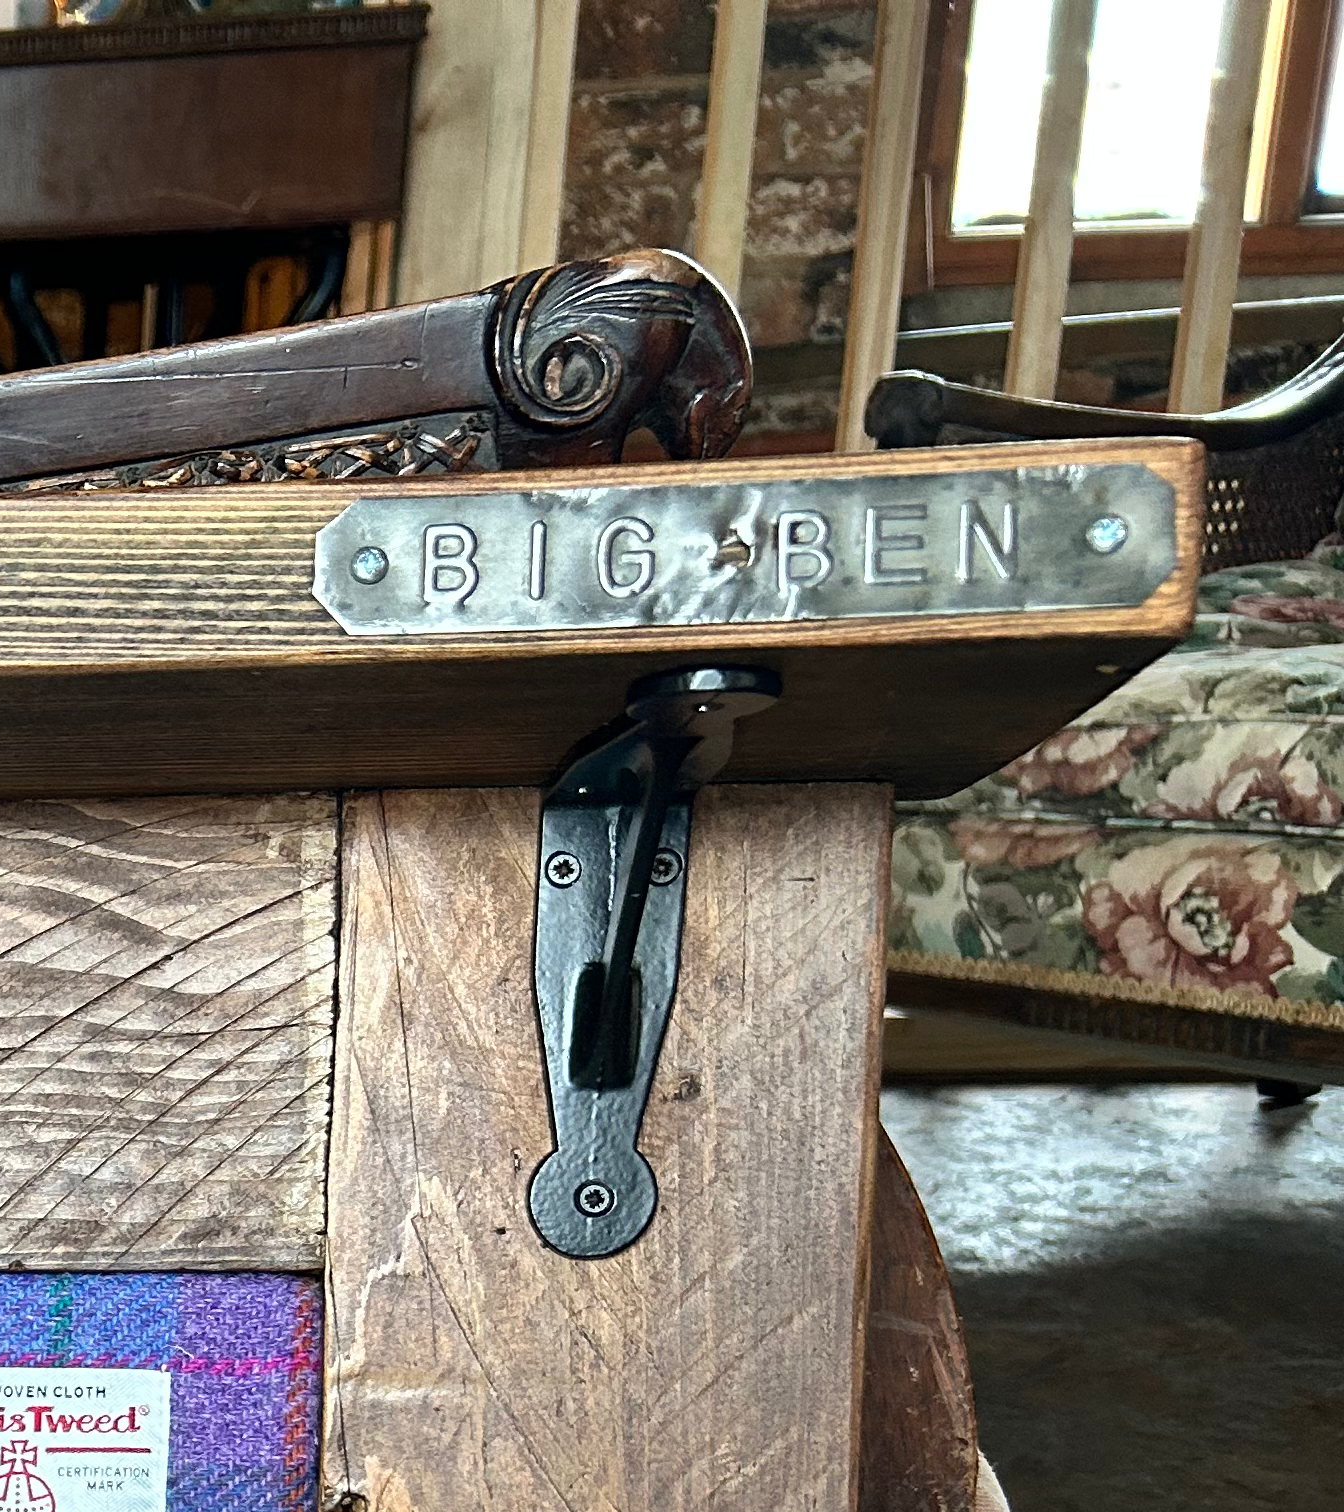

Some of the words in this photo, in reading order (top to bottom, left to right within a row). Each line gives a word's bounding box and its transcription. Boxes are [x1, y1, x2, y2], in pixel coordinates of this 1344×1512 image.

[421, 516, 657, 604] BIG
[774, 500, 1021, 598] BEN
[53, 1386, 107, 1399] CLOTH
[57, 1467, 150, 1478] CERTIFICATION
[86, 1481, 125, 1492] MARK
